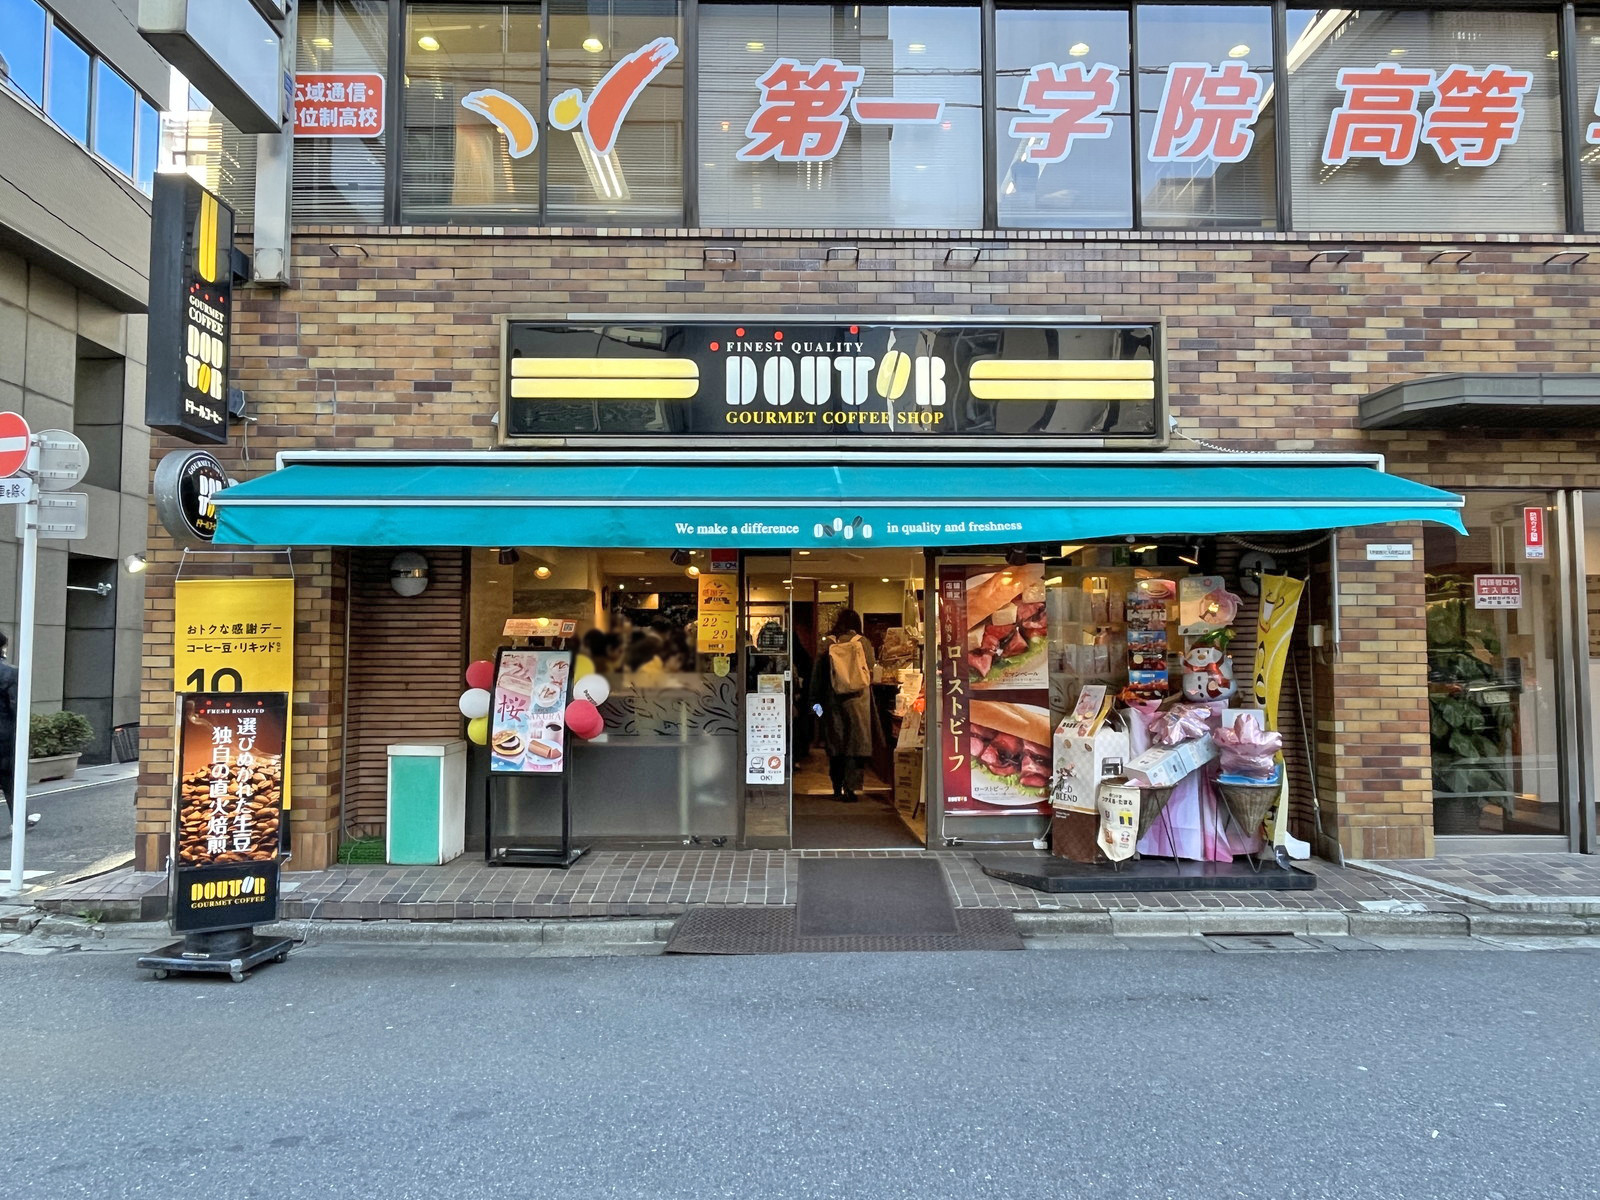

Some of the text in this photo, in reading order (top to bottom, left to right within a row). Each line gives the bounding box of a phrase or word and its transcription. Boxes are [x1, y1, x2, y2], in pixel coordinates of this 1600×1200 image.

[294, 107, 378, 128] 位制高校
[189, 295, 225, 322] GOURMET
[188, 306, 224, 336] COFFEE
[726, 342, 864, 354] FINEST QUALITY
[725, 350, 947, 406] DOUTOR
[725, 411, 944, 424] GOURMET COFFEE SHOP
[675, 523, 800, 534] We make a difference
[887, 521, 1023, 535] in quality and freshness
[187, 623, 282, 635] おトクな感謝デー
[497, 694, 525, 723] 桜
[946, 645, 966, 773] ローストビーフ
[206, 726, 233, 855] 独自の直火焙煎
[231, 717, 257, 853] 選びぬかれた生豆
[1055, 792, 1078, 803] BLEND
[190, 875, 267, 901] DOUTOR
[190, 896, 266, 909] GOURMET COFFEE
